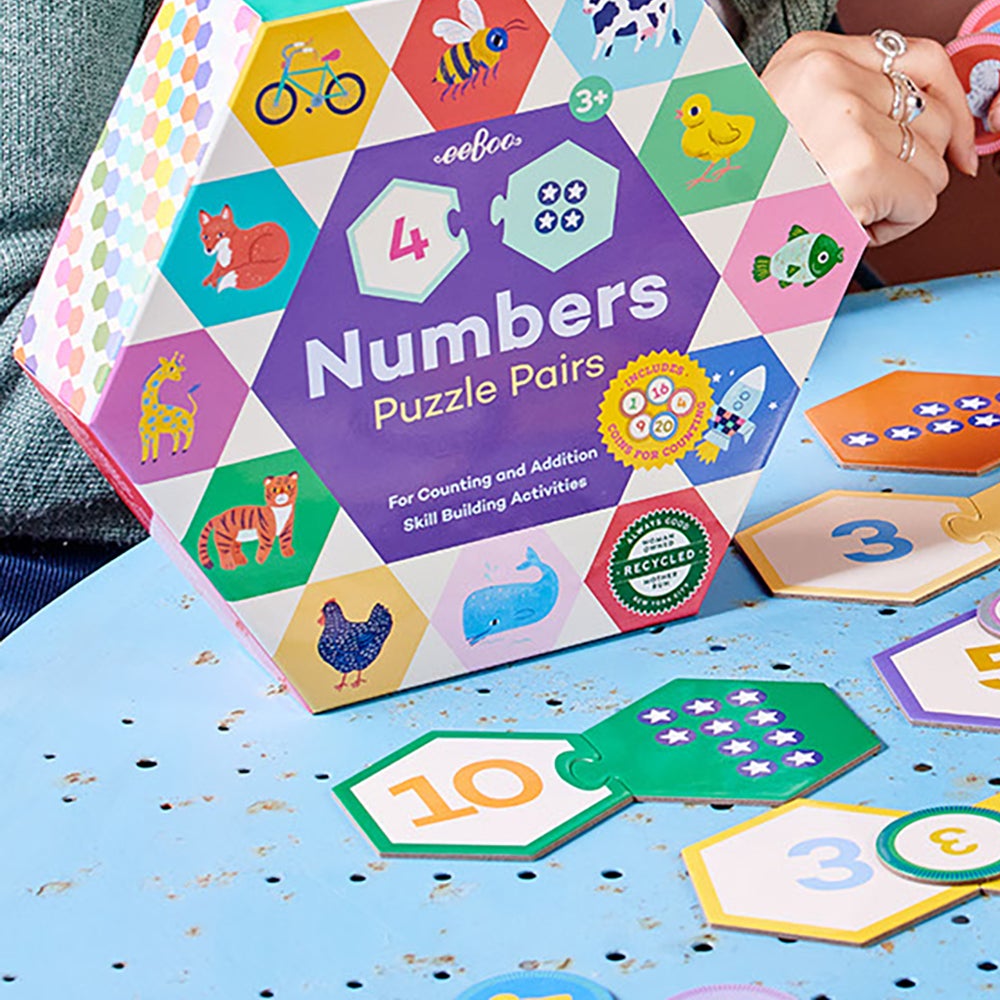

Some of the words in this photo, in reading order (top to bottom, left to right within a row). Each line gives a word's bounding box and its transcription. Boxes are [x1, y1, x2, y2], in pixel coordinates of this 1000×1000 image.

[575, 88, 608, 113] 3+
[388, 215, 429, 261] 4
[304, 273, 669, 399] Numbers
[373, 376, 497, 430] Puzzle
[510, 353, 605, 396] Pairs
[624, 362, 685, 387] INCLUDES
[652, 382, 670, 400] 16
[606, 422, 634, 456] COINS
[633, 450, 659, 461] FOR
[662, 401, 706, 457] COUNTING
[654, 419, 673, 433] 20
[388, 493, 414, 509] For
[416, 472, 492, 502] Counting
[495, 462, 526, 482] and
[530, 448, 598, 474] Addition
[403, 511, 438, 532] Skill
[441, 498, 506, 522] Building
[510, 477, 587, 505] Activities
[623, 549, 695, 576] RECYCLED
[831, 519, 914, 563] 3
[387, 758, 544, 827] 10
[787, 837, 875, 891] 3
[929, 827, 979, 855] 3
